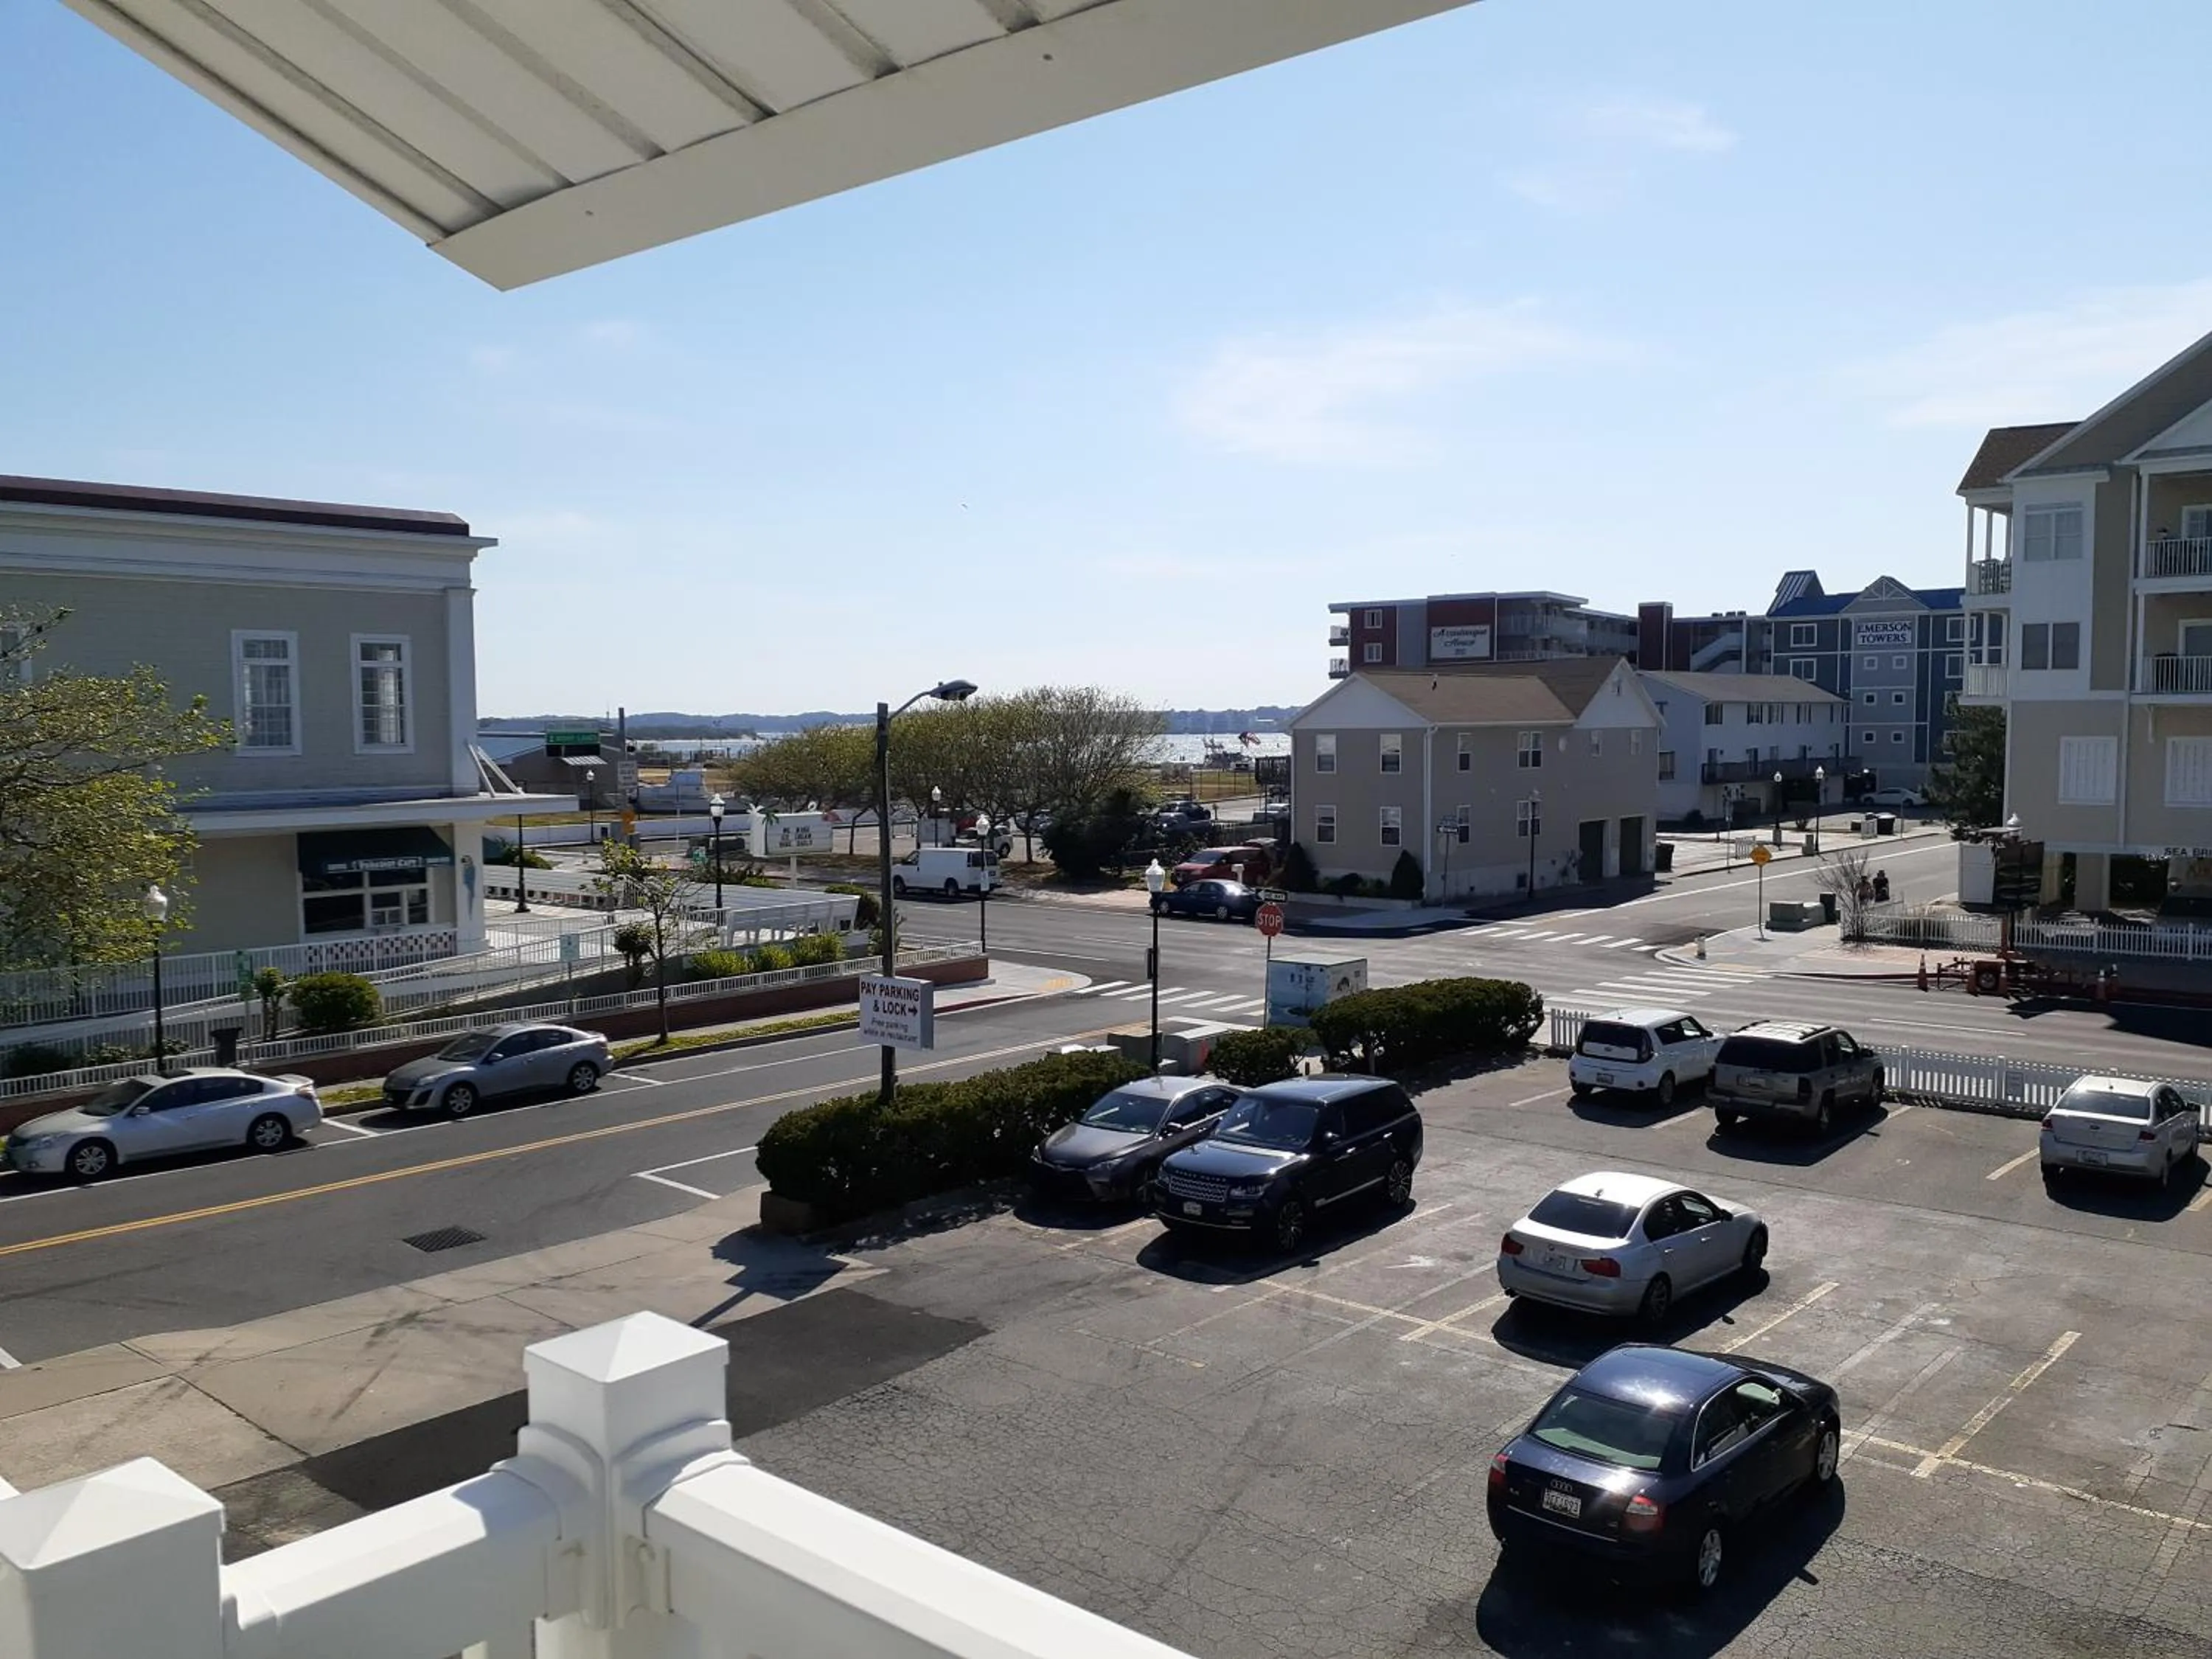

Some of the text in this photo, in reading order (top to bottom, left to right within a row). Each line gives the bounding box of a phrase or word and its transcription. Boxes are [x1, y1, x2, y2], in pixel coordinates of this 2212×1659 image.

[1858, 622, 1912, 633] EMERSON
[1860, 633, 1906, 644] TOWERS
[2164, 847, 2187, 855] SEA
[1258, 913, 1281, 927] STOP
[860, 981, 919, 1001] PAY PARKING
[873, 1000, 906, 1016] & LOCK
